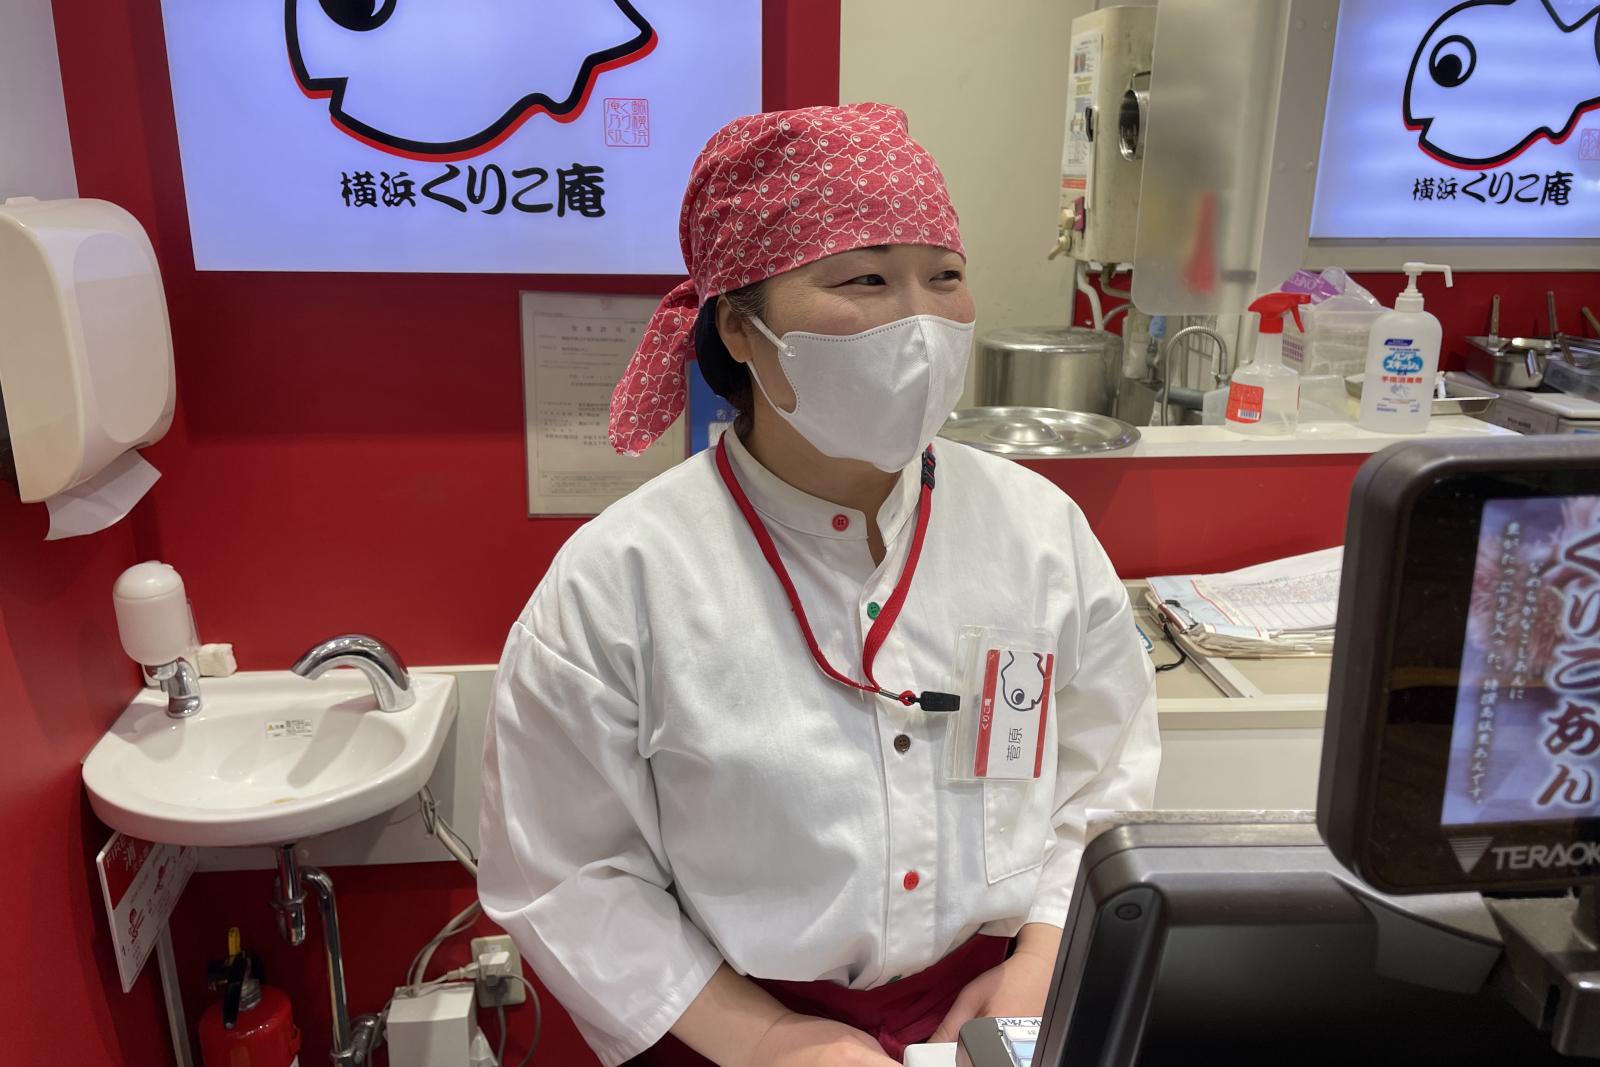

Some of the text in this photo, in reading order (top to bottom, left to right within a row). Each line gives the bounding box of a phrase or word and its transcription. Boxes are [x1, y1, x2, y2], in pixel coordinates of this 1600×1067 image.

[340, 163, 606, 218] 横浜くりこ庵
[1412, 171, 1574, 206] 横浜くりこ庵
[105, 834, 127, 869] FIRE
